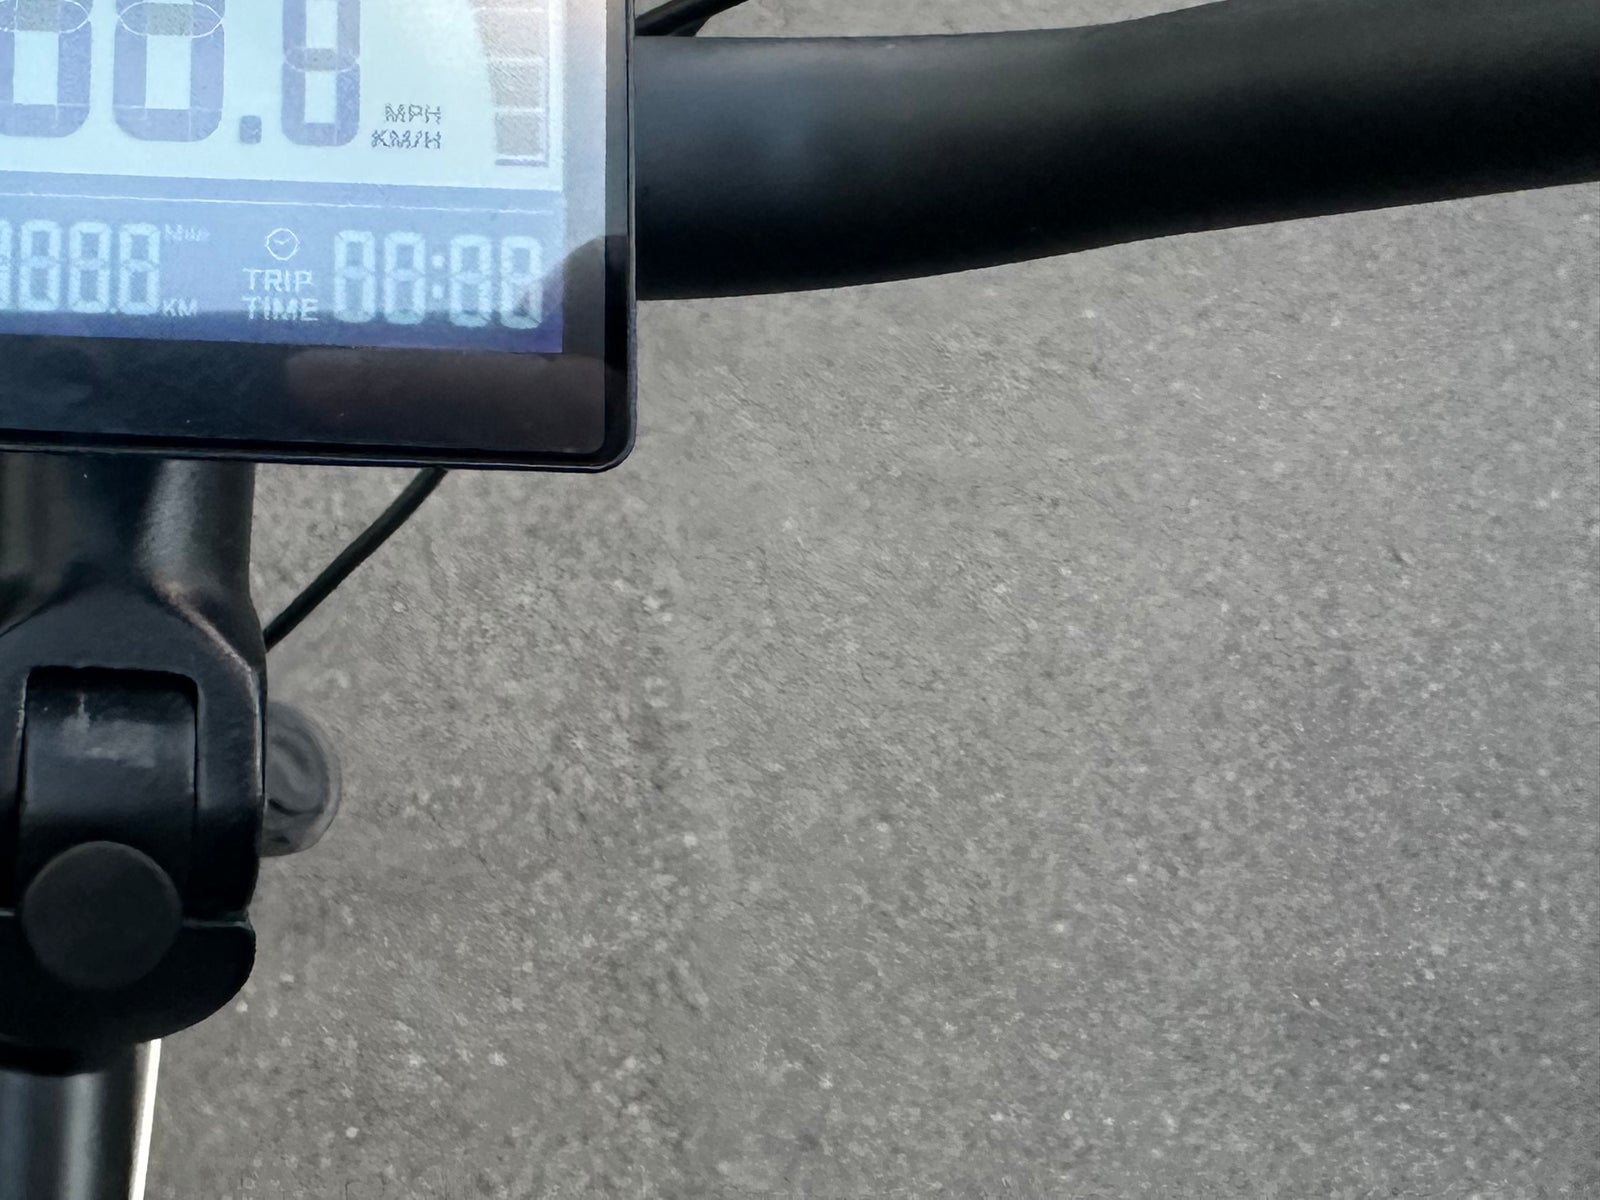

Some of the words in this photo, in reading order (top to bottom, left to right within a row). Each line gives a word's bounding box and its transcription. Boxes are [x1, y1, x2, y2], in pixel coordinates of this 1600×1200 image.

[385, 104, 441, 123] MPH
[242, 268, 313, 293] TRIP
[242, 297, 319, 321] TIME
